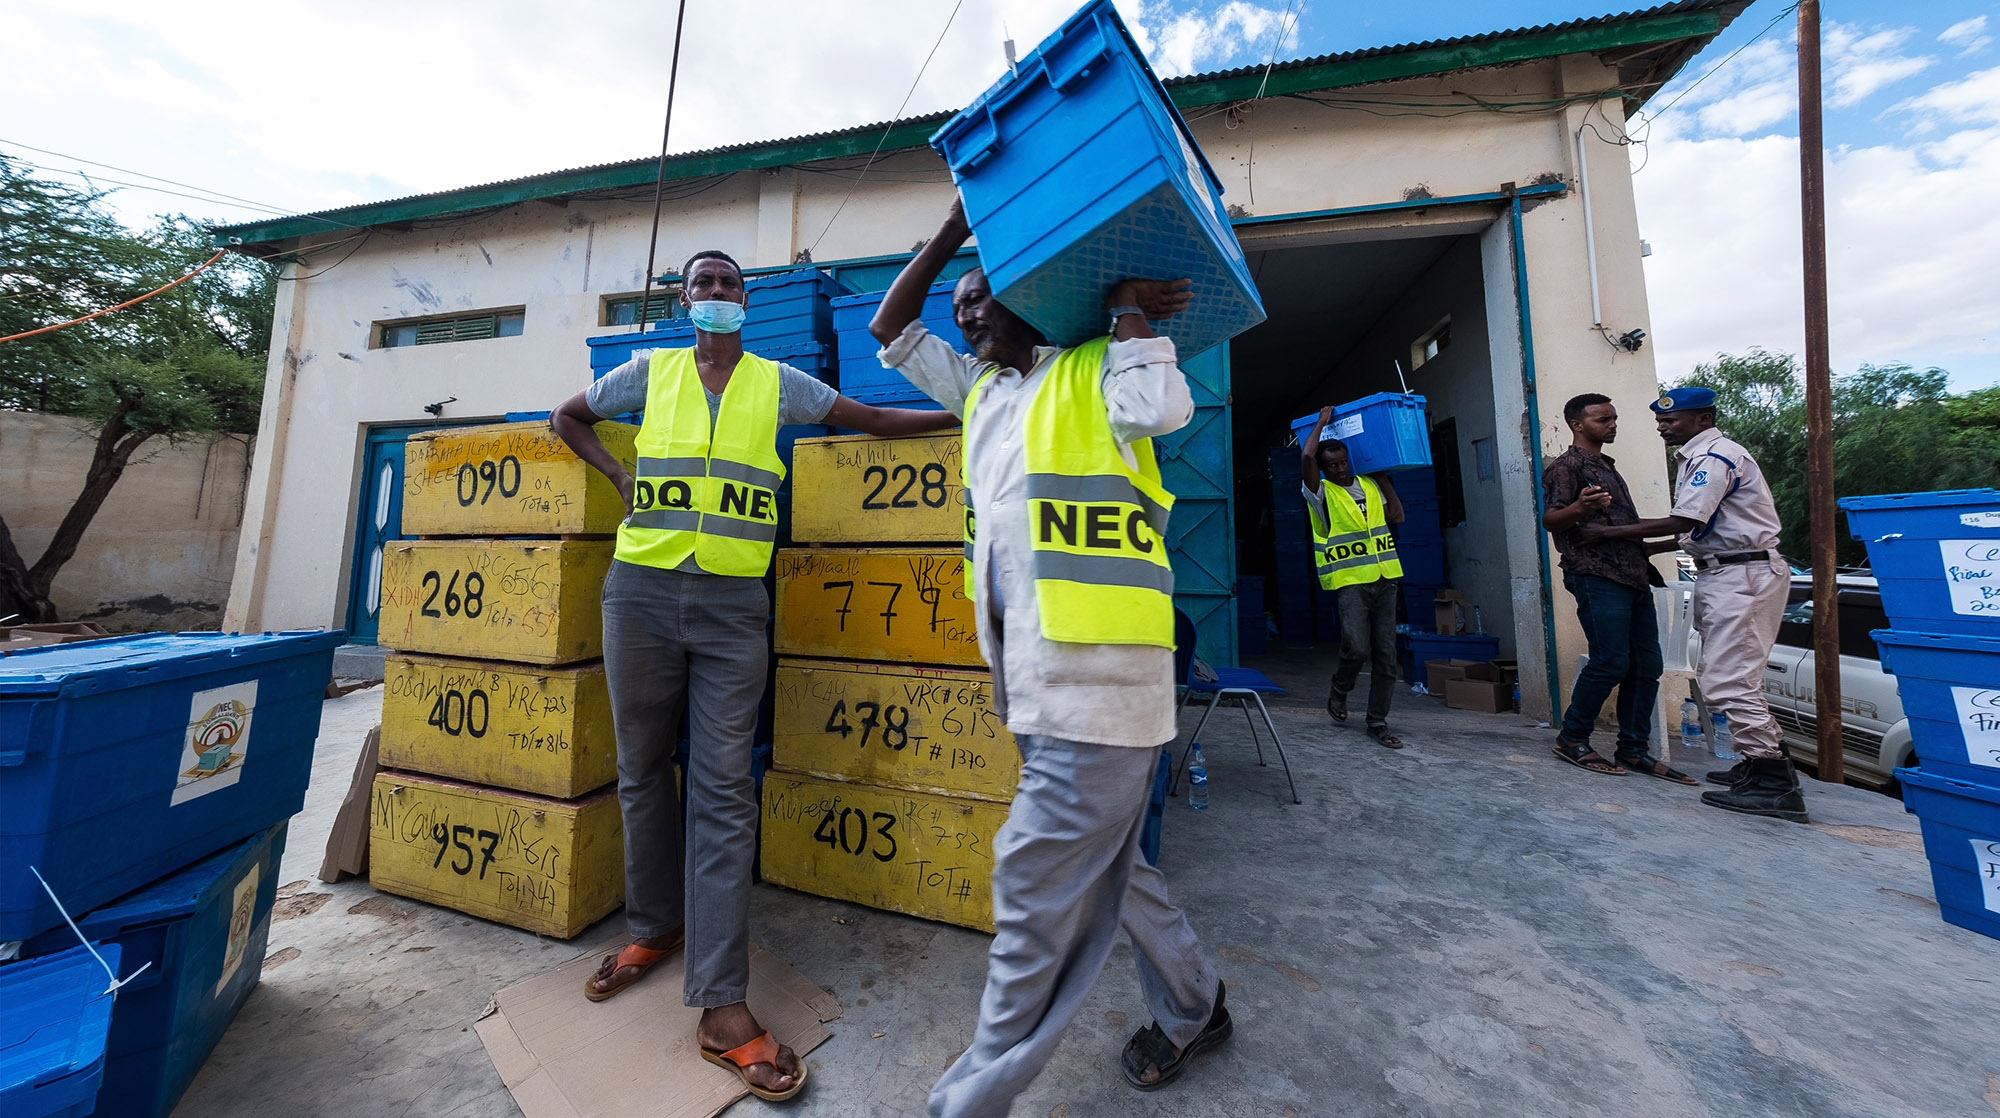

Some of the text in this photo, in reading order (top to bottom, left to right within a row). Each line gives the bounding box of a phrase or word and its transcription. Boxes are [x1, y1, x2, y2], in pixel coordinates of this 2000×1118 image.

[457, 454, 521, 508] 090
[862, 463, 947, 509] 228
[1040, 501, 1154, 554] NEC
[1324, 542, 1369, 563] KDQ
[421, 569, 485, 619] 268
[218, 702, 232, 712] NEC
[427, 688, 489, 739] 400
[1761, 677, 1878, 719] RUIER
[825, 699, 909, 751] 478
[433, 823, 500, 880] 957
[813, 807, 897, 862] 403
